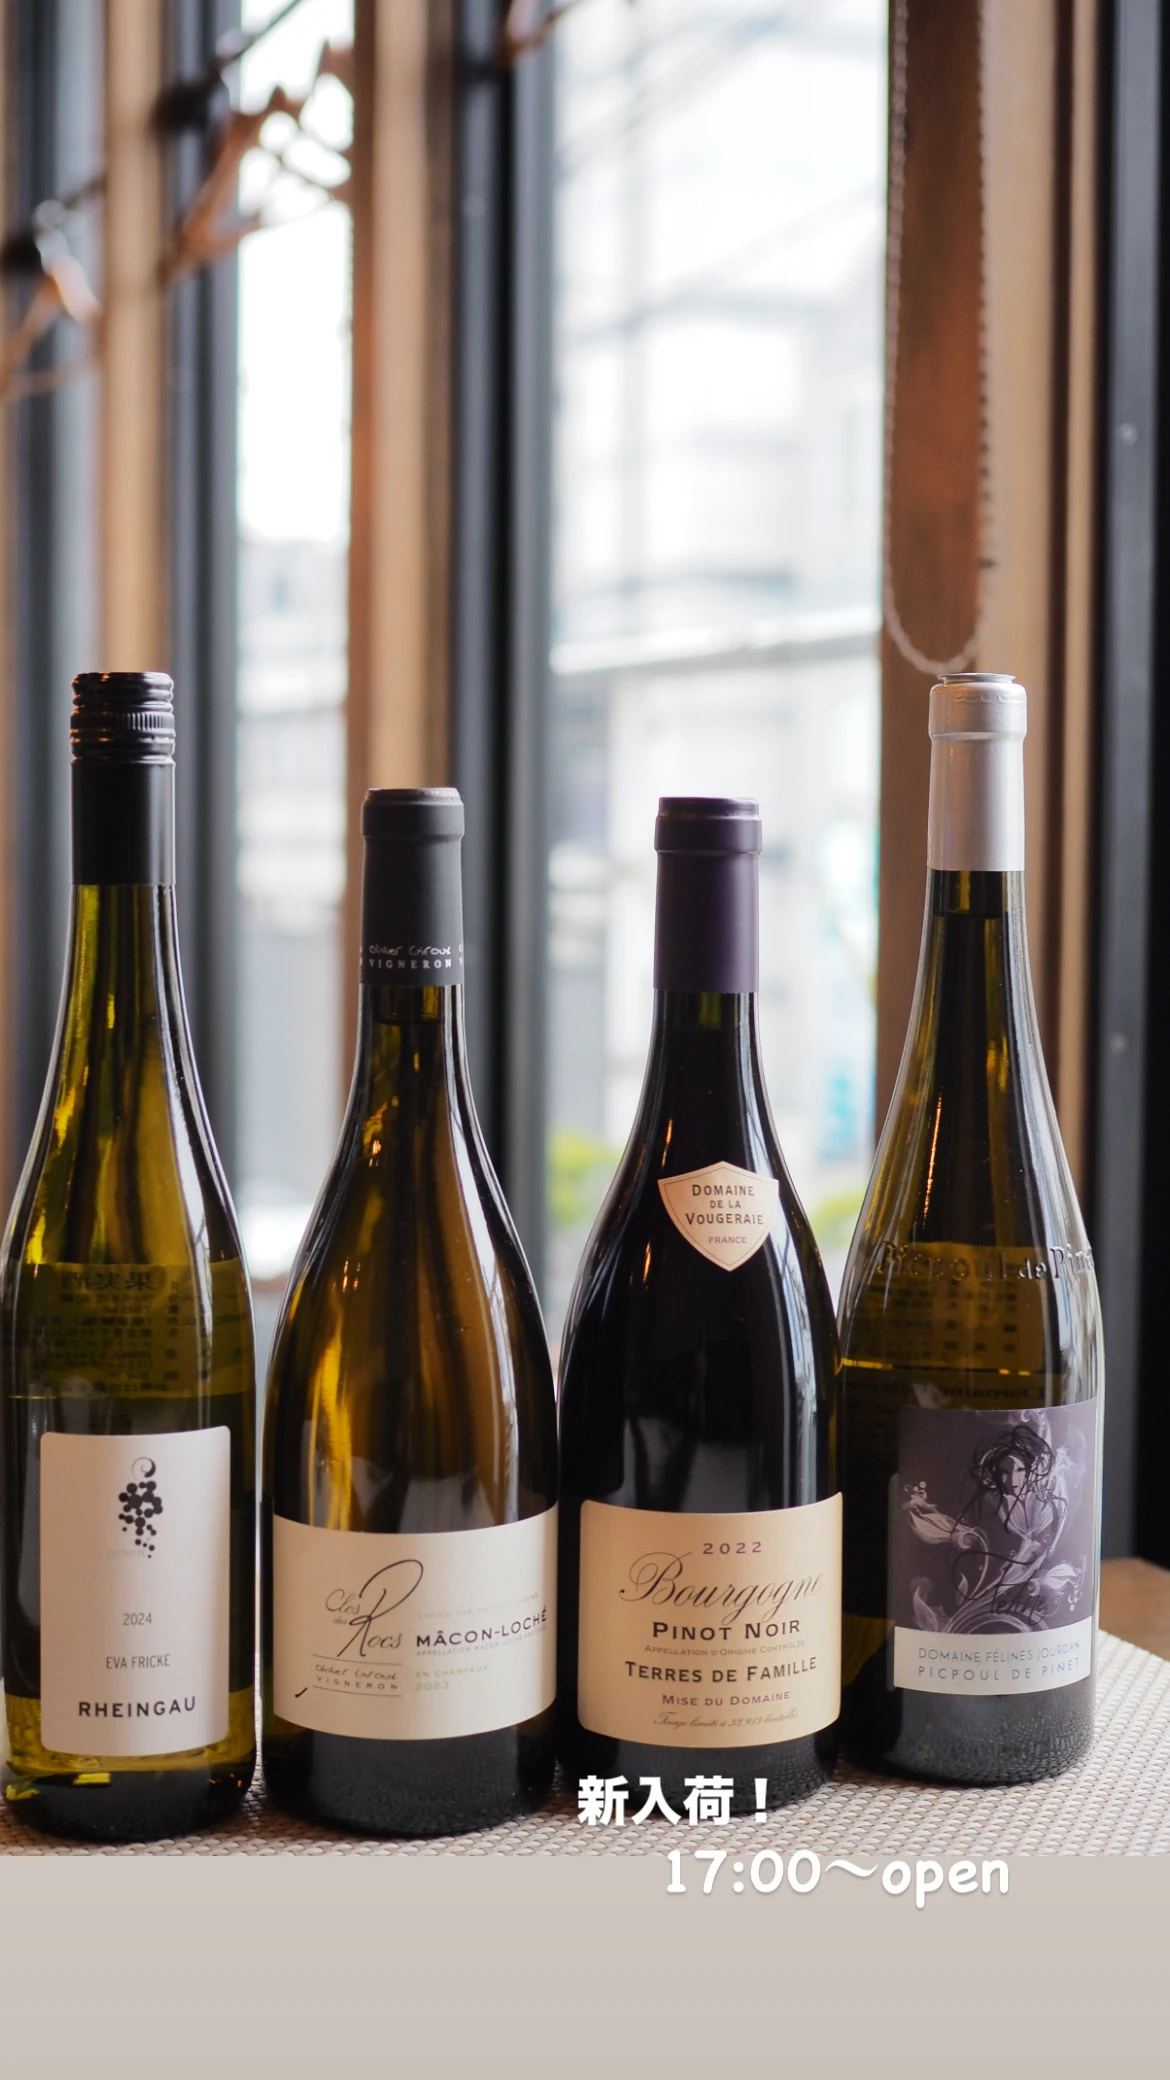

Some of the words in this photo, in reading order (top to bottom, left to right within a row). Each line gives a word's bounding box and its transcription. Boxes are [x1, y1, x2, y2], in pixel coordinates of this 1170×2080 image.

[369, 959, 452, 968] VIGNERON
[692, 1184, 755, 1196] DOMAINE
[710, 1200, 724, 1208] DE
[729, 1200, 742, 1208] LA
[686, 1213, 764, 1225] VOUGERAIE
[708, 1236, 747, 1244] FRANCE
[703, 1541, 762, 1555] 2022
[618, 1551, 824, 1625] Bourgogne
[325, 1588, 360, 1615] Clos
[336, 1559, 424, 1658] Rocs
[123, 1612, 152, 1626] 2024
[333, 1616, 347, 1625] des
[416, 1604, 548, 1648] MÂCON-LOCHÉ
[652, 1621, 732, 1641] PINOT
[745, 1620, 800, 1640] NOIR
[644, 1644, 708, 1656] APPELLATION
[918, 1648, 980, 1662] DOMAINE
[986, 1648, 1032, 1662] FÉLINES
[1037, 1640, 1080, 1661] JOURDAN
[106, 1656, 128, 1670] EVA
[132, 1654, 171, 1668] FRICKE
[625, 1661, 702, 1683] TERRES
[712, 1669, 737, 1683] DE
[747, 1656, 816, 1682] FAMILLE
[918, 1666, 998, 1681] PICPOUL
[1012, 1668, 1031, 1680] DE
[1042, 1658, 1080, 1676] PINET
[316, 1676, 398, 1690] VIGNERON
[662, 1694, 698, 1706] MISE
[705, 1698, 723, 1706] DU
[730, 1691, 790, 1706] DOMAINE
[78, 1696, 196, 1718] RHEINGAU
